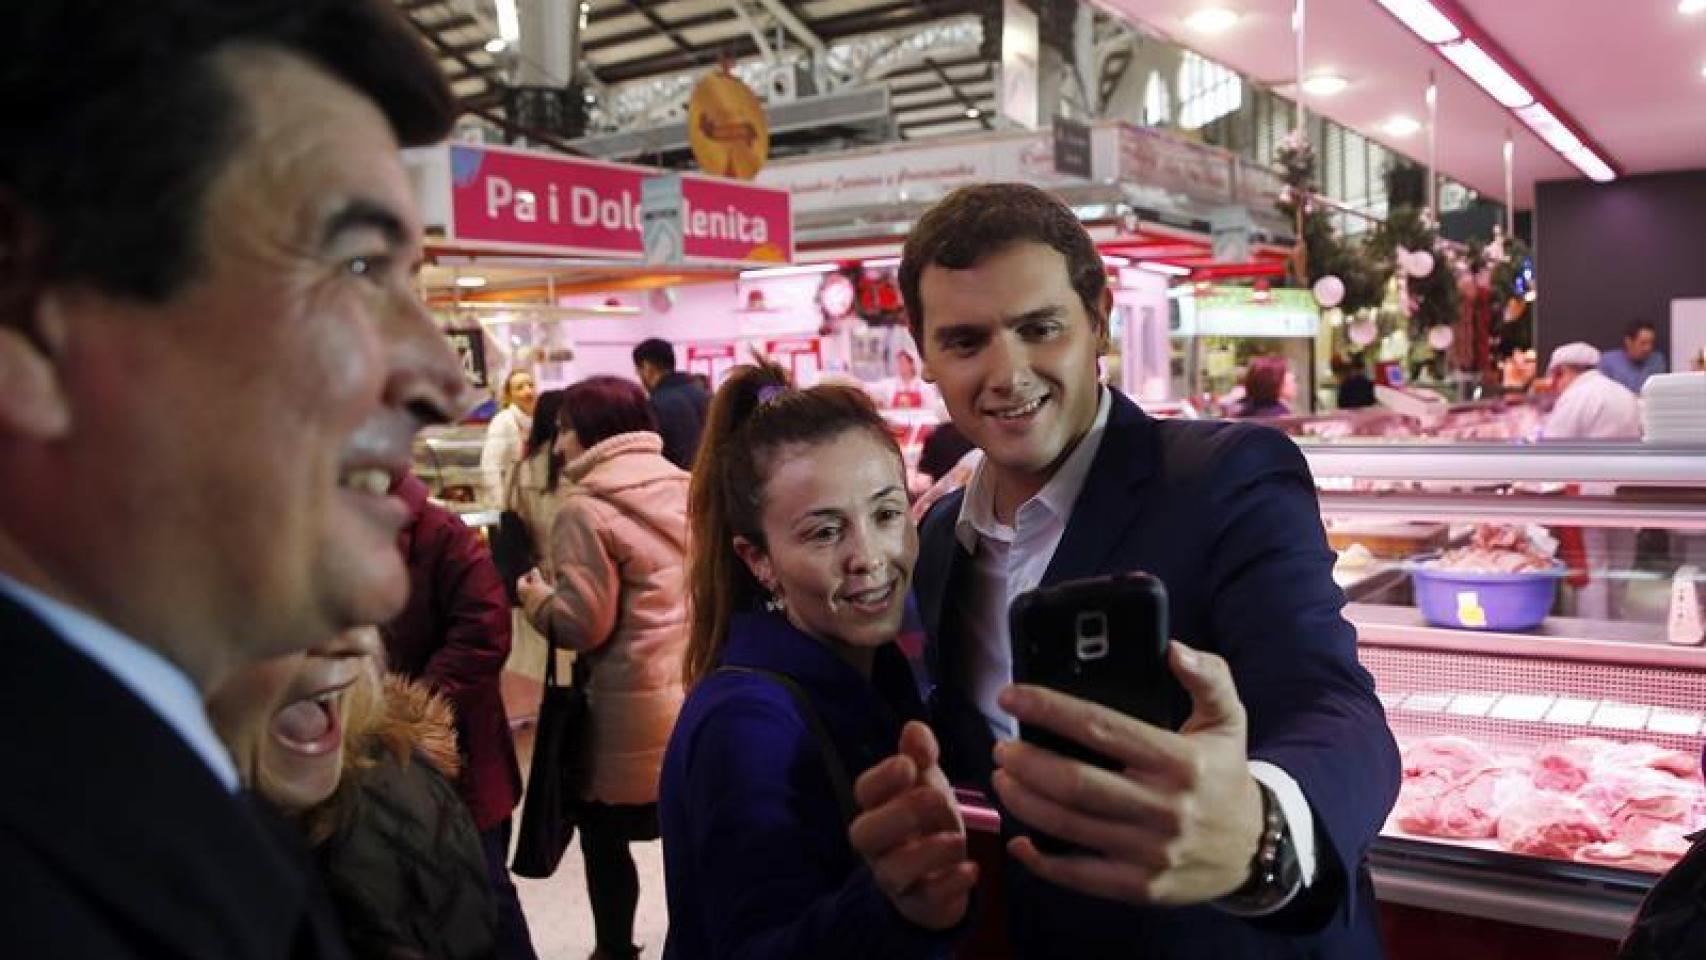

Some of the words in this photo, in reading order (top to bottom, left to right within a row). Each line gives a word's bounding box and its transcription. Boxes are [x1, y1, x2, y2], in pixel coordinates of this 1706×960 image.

[485, 176, 537, 222] Pa
[548, 183, 560, 224] i
[682, 198, 769, 242] lenita
